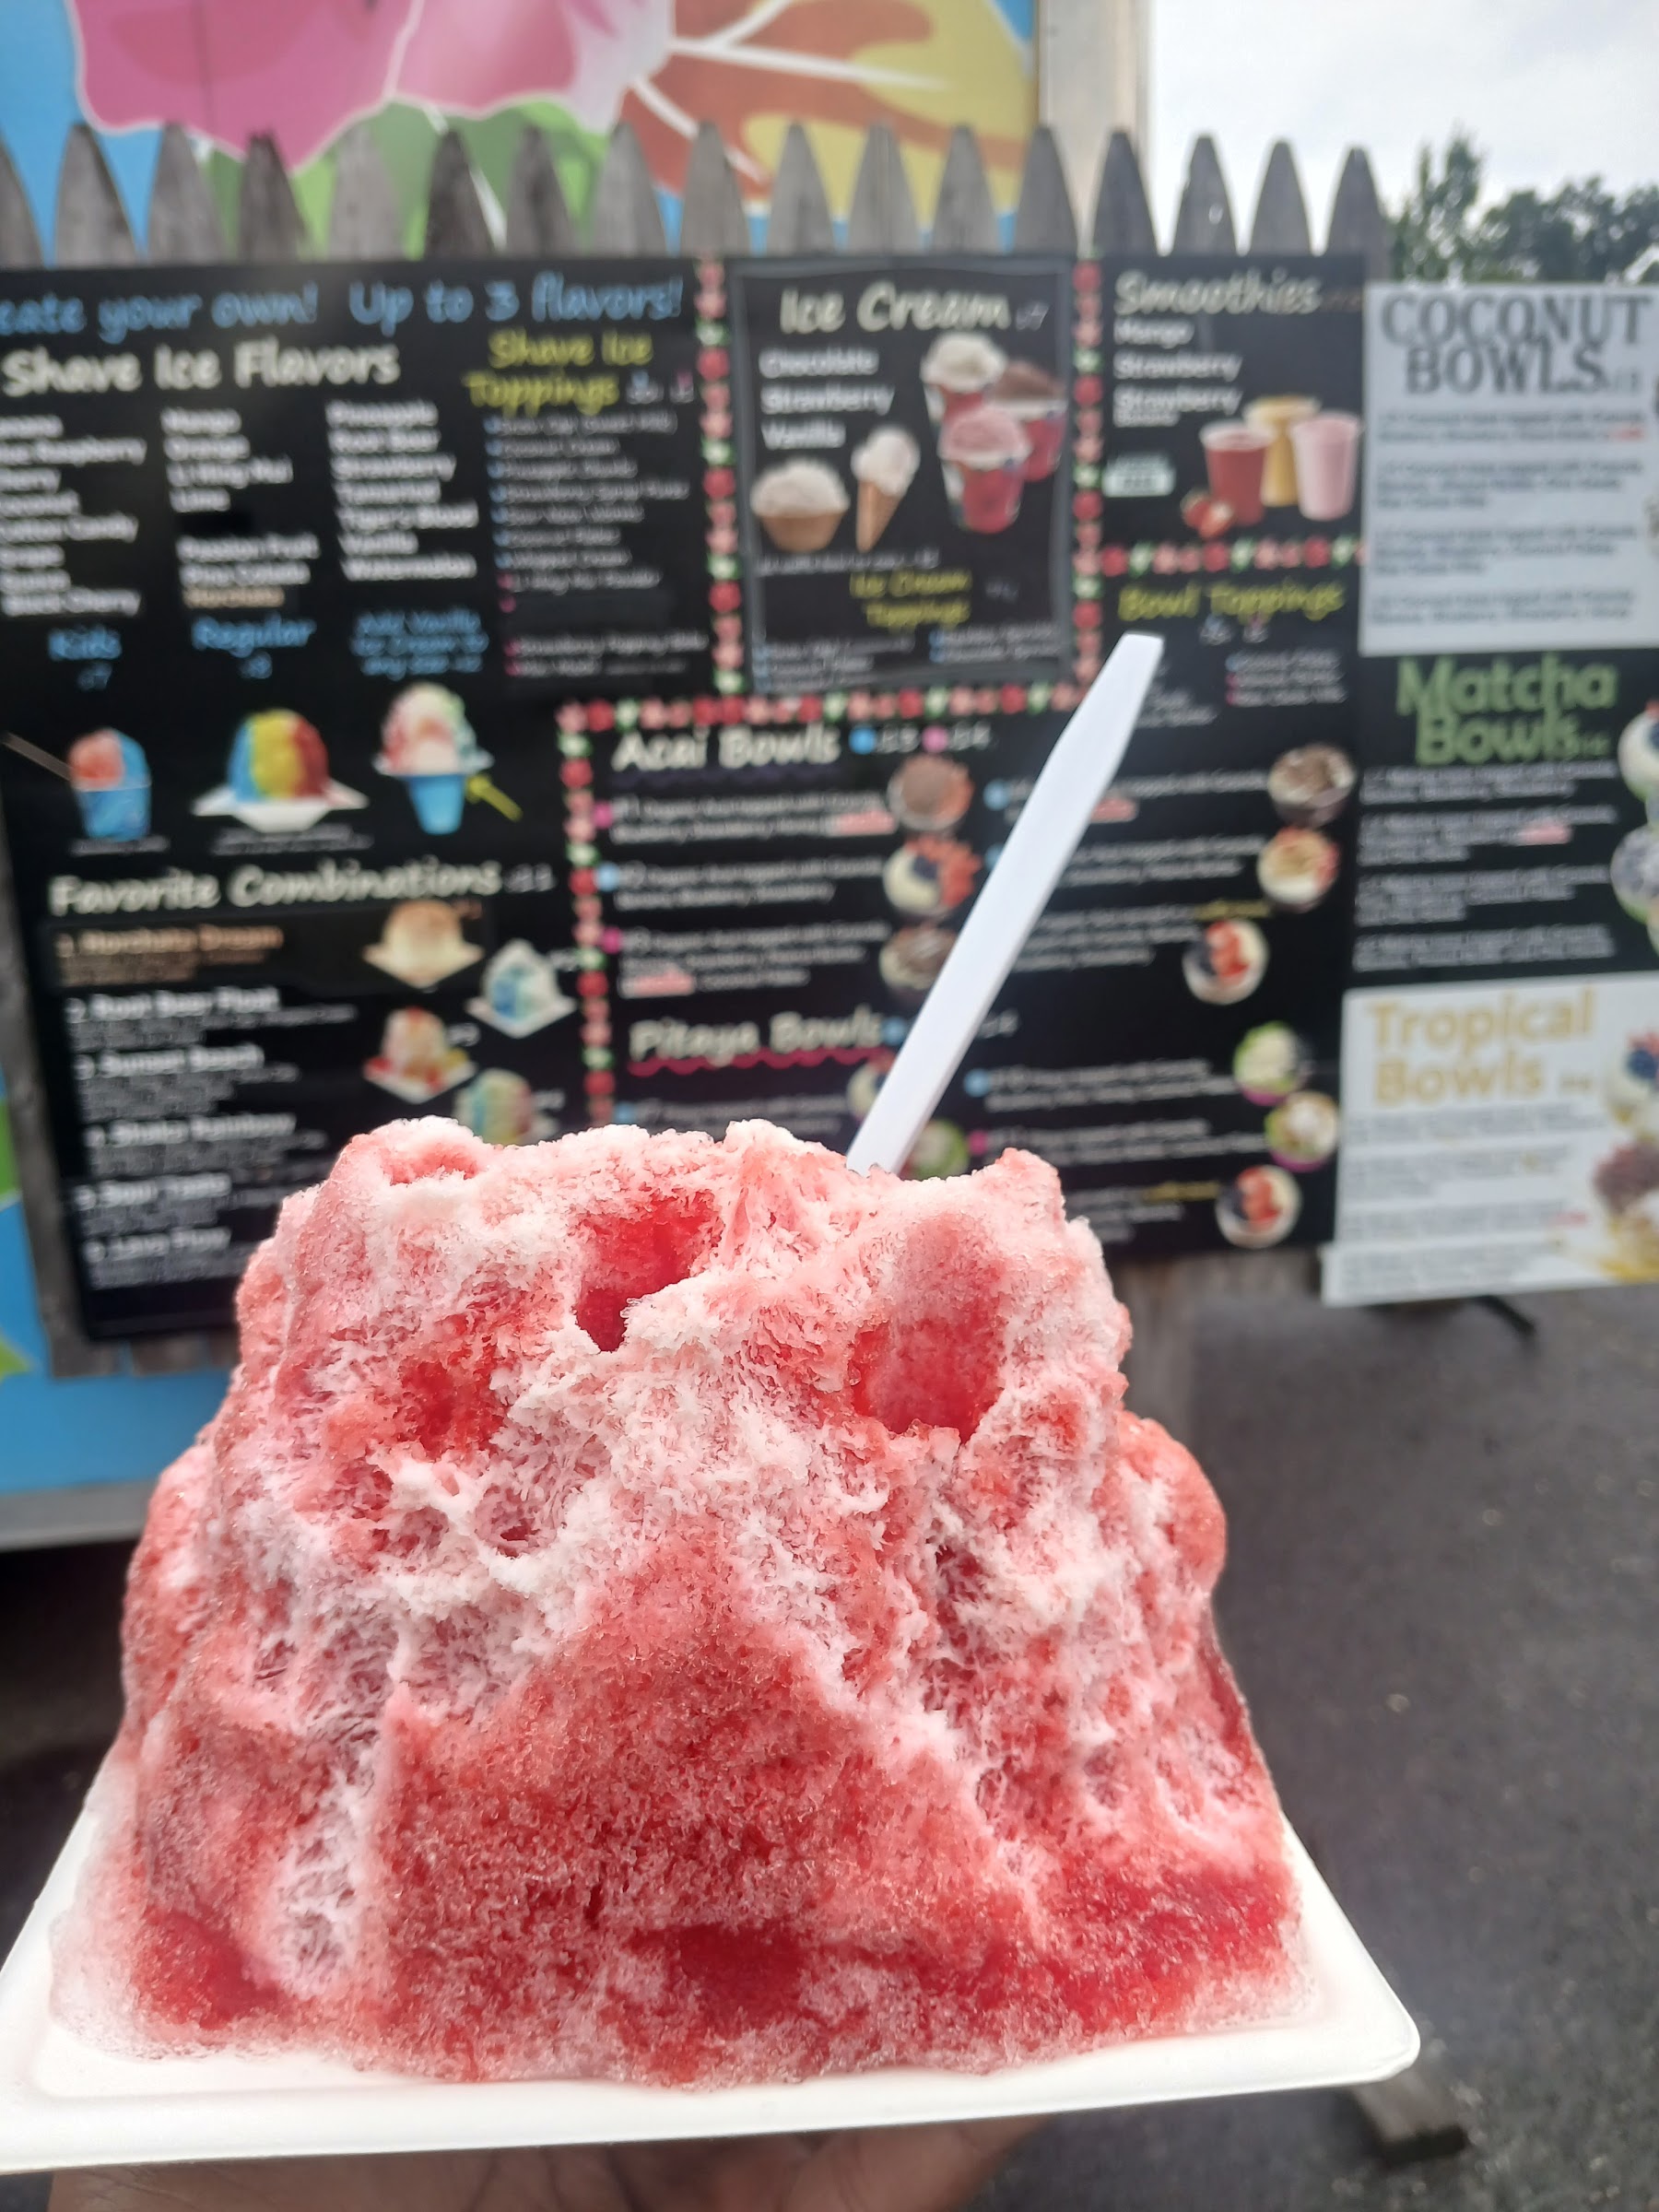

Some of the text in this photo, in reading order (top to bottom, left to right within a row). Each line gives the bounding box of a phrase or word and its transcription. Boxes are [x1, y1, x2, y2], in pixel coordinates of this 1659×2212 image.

[97, 292, 202, 344] your
[211, 279, 319, 329] own!
[348, 279, 414, 337] Up
[426, 279, 474, 324] to
[485, 279, 520, 323] 3
[530, 270, 683, 323] flavors!
[778, 287, 845, 335] Ice
[857, 280, 1011, 332] Cream
[1114, 266, 1322, 315] Smoothies
[1382, 291, 1653, 347] COCONUT
[3, 335, 400, 397] Shave Ice Flavors
[488, 326, 653, 369] Shave Ice
[1406, 335, 1609, 394] BOWLS
[463, 370, 620, 417] Toppings
[1118, 581, 1198, 621] Bowl
[192, 614, 317, 657] Regular
[1396, 650, 1618, 715] Matcha
[611, 724, 711, 771] Acai
[719, 721, 842, 770] Bowls
[1416, 702, 1580, 766] Bowls
[49, 868, 221, 917] Favorite
[227, 854, 502, 908] Combinations
[629, 1005, 882, 1067] Pitaya Bowls
[1370, 984, 1594, 1057] Tropical
[1375, 1048, 1544, 1108] Bowls
